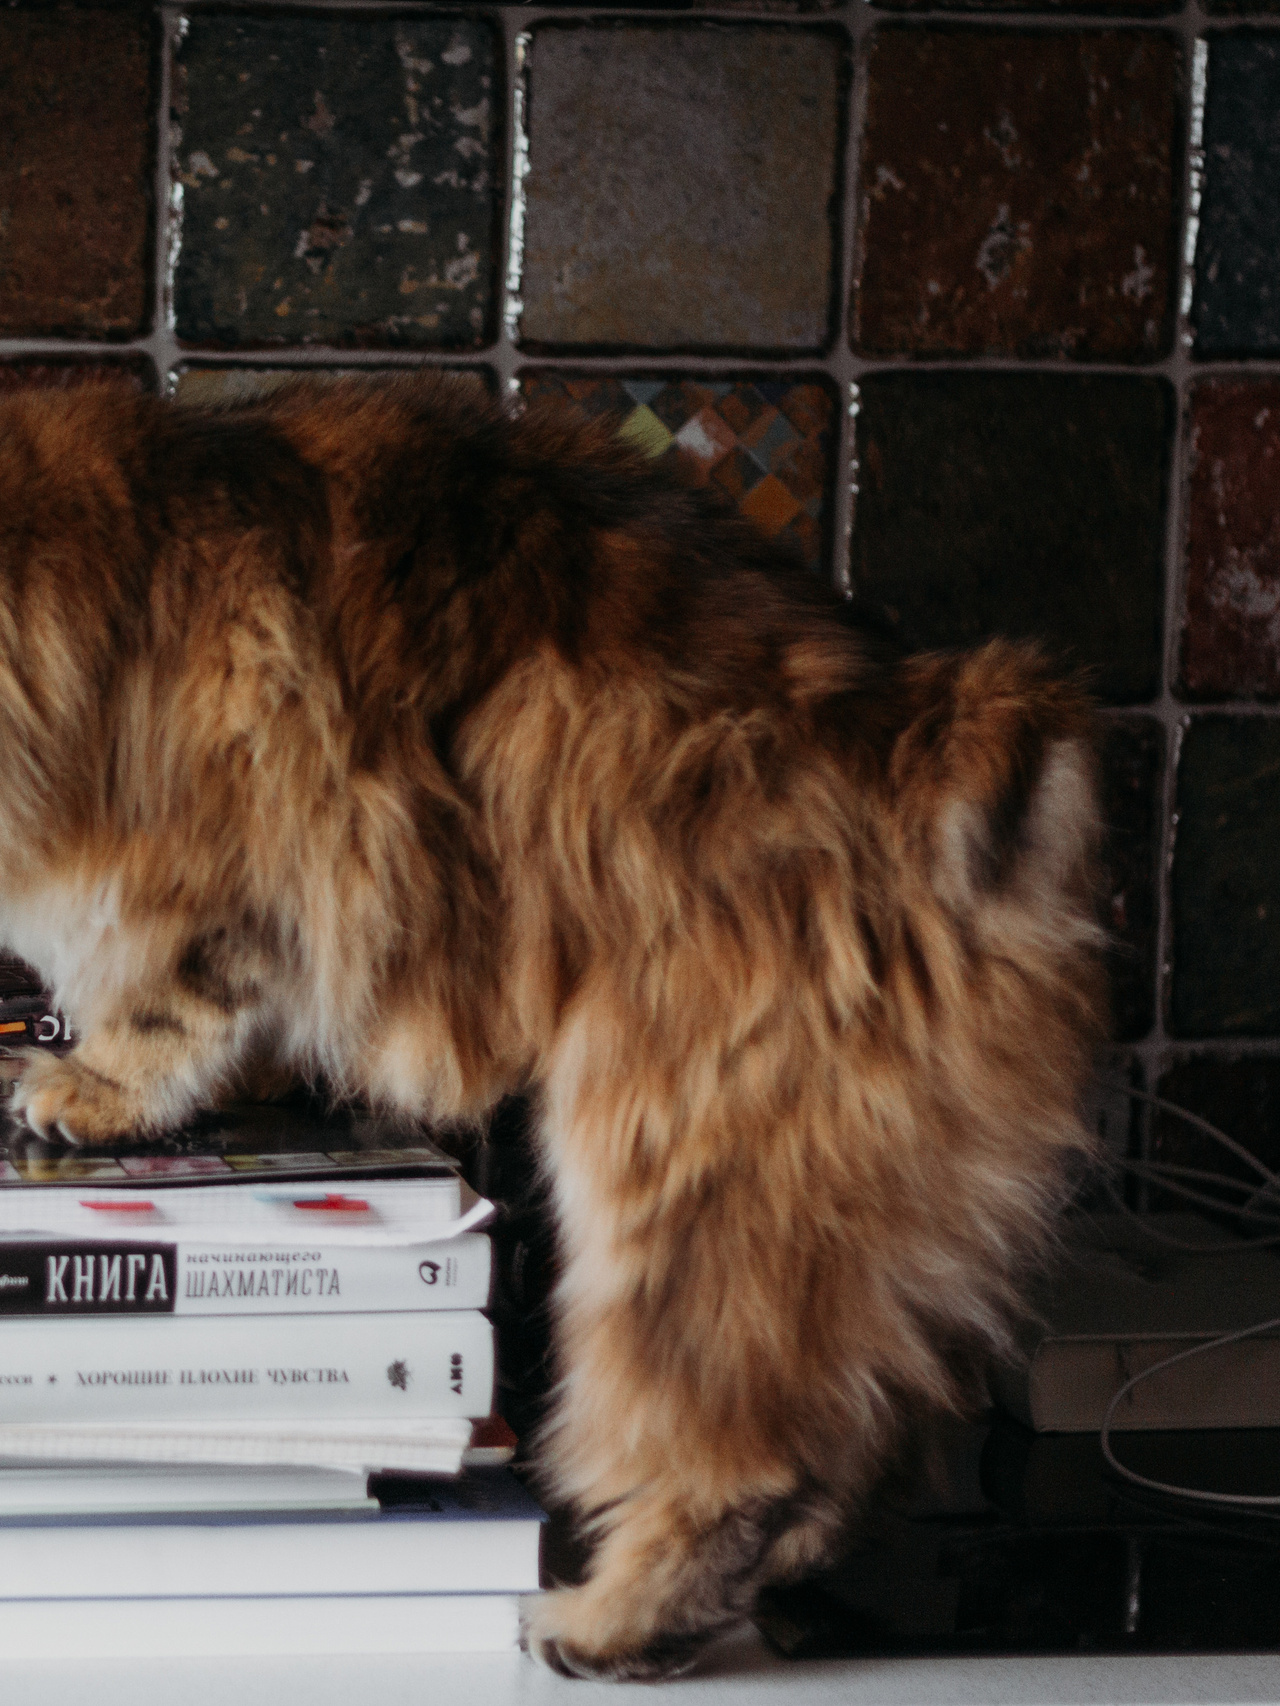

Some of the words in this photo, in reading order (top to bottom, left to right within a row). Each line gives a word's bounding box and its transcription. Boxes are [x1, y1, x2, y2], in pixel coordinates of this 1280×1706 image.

[185, 1251, 322, 1265] начинающего
[46, 1253, 169, 1302] КНИГА
[184, 1267, 342, 1298] ШАХМАТИСТА
[75, 1368, 169, 1386] ХОРОШИЕ
[179, 1368, 255, 1385] ПЛОХИЕ
[267, 1367, 350, 1385] ЧУВСТВА
